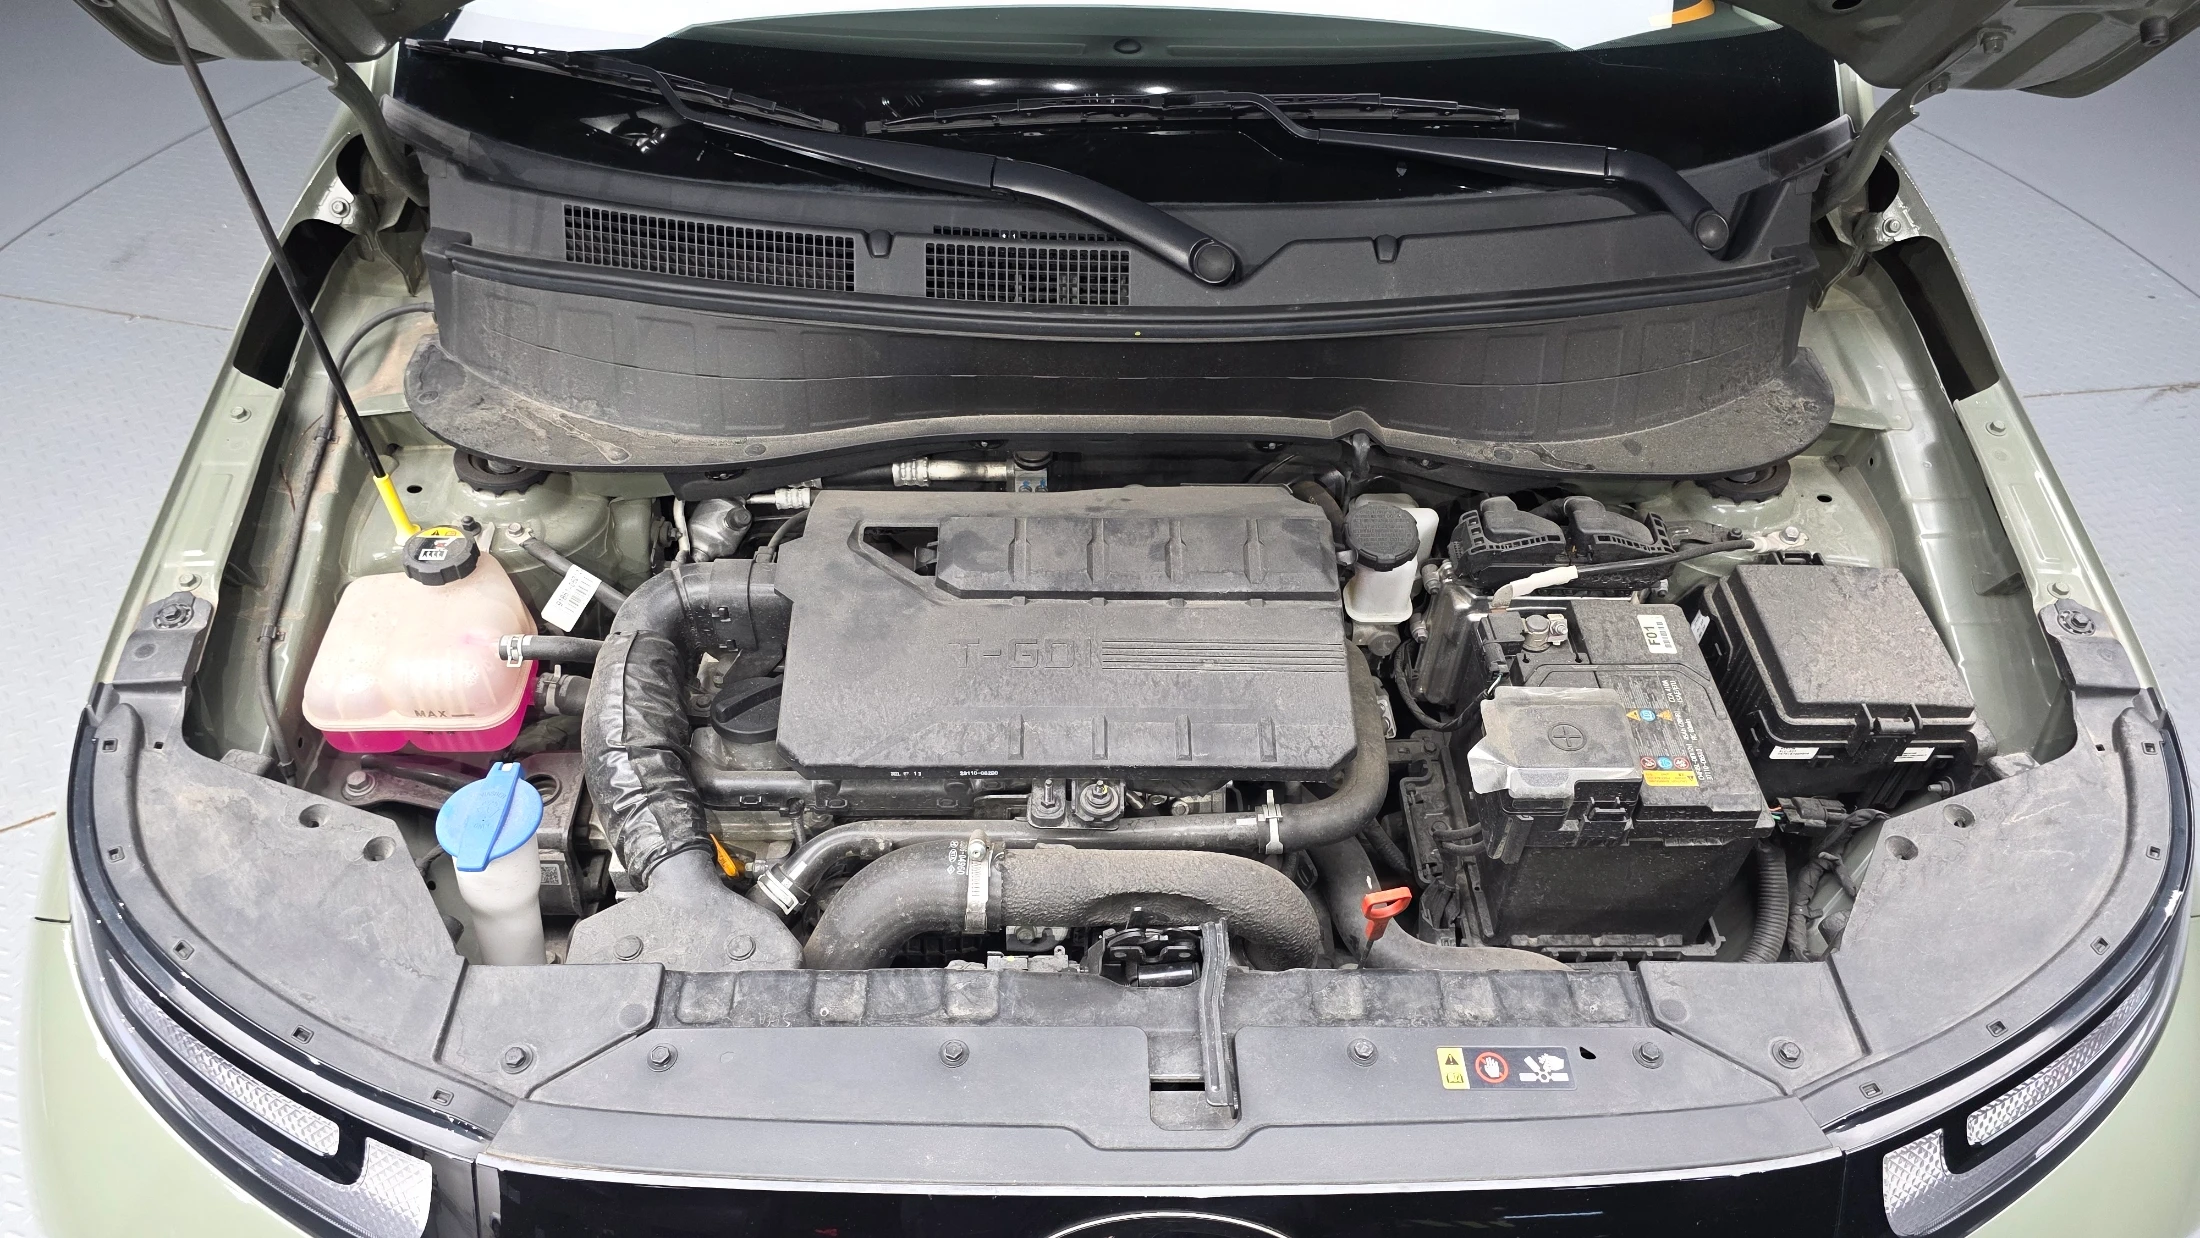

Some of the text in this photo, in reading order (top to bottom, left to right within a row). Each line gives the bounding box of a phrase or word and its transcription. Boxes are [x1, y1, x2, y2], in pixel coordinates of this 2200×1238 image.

[1643, 626, 1661, 645] F01
[947, 638, 1092, 669] T-GDI
[413, 709, 448, 718] MAX
